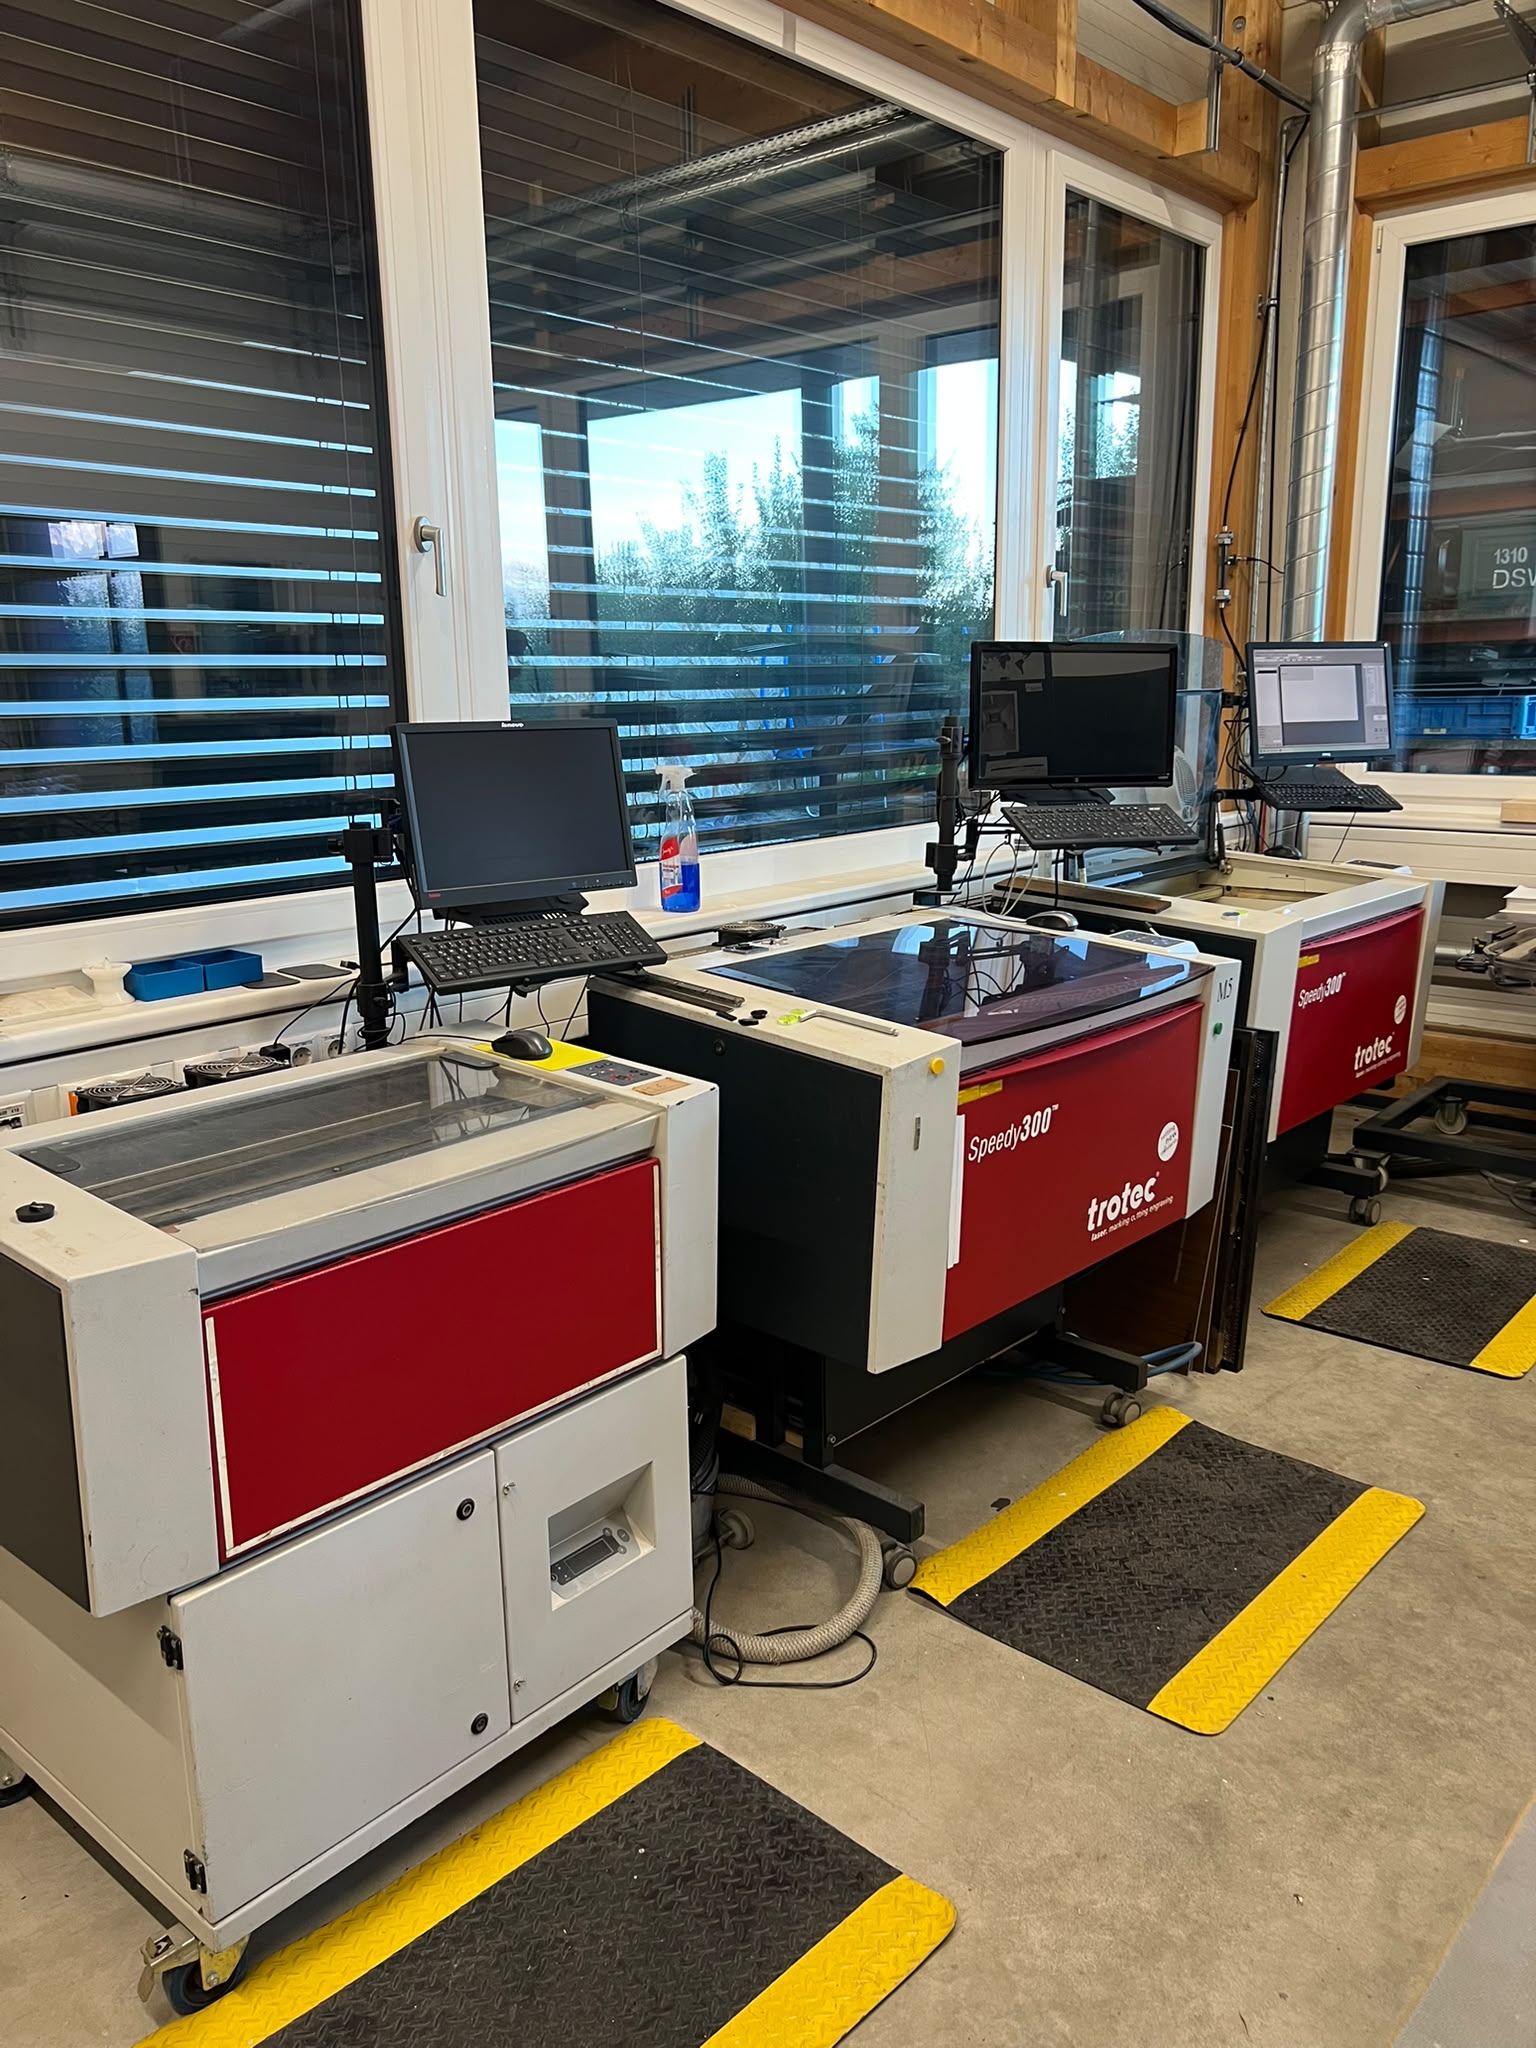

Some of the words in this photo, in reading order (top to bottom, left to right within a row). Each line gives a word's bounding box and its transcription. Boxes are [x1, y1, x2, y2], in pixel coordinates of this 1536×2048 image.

[1493, 546, 1528, 565] 1310
[1216, 977, 1233, 1002] M5
[1354, 1036, 1394, 1070] trotec
[1087, 1175, 1159, 1232] trotec
